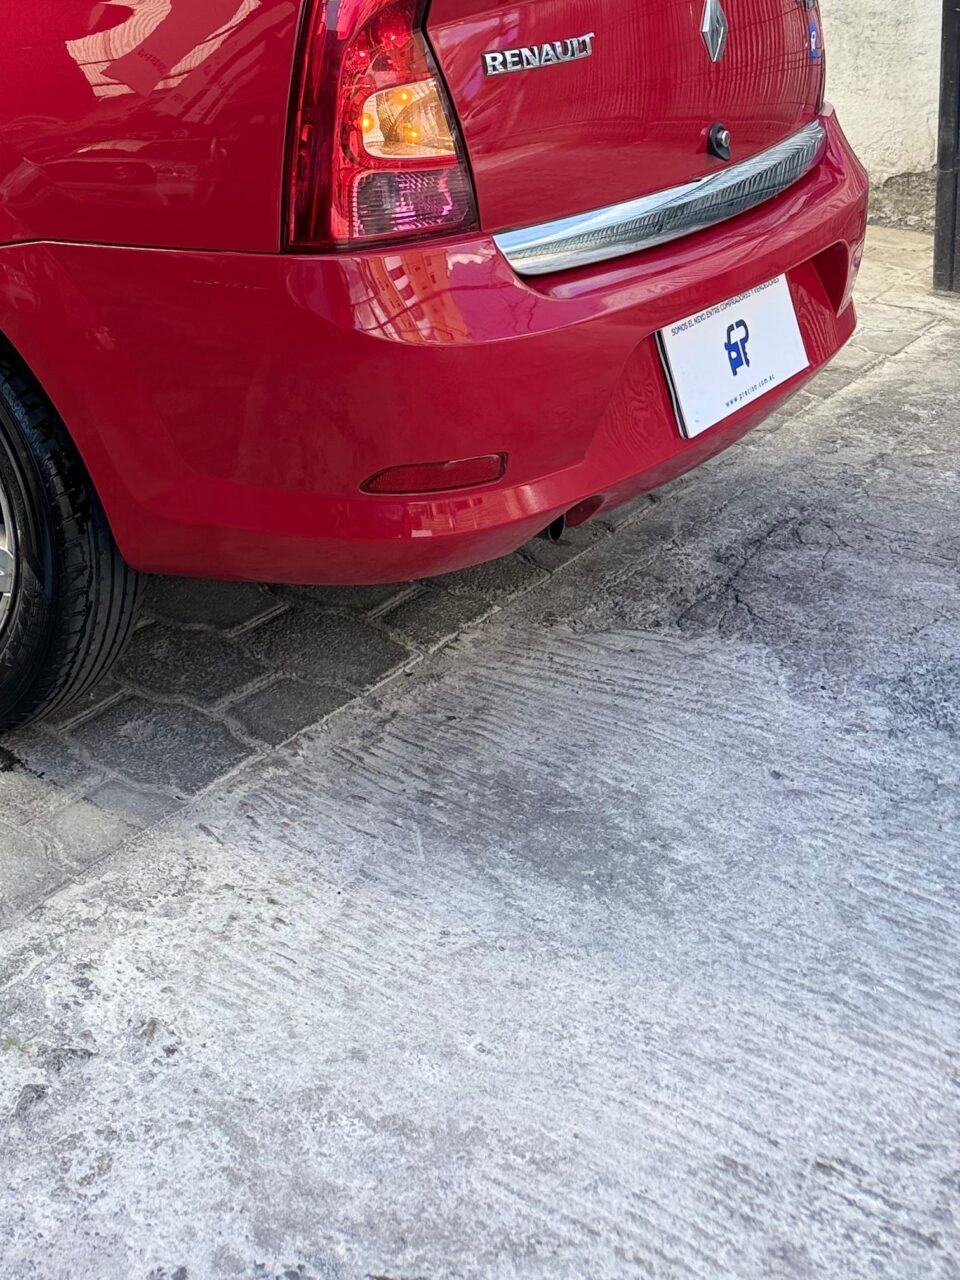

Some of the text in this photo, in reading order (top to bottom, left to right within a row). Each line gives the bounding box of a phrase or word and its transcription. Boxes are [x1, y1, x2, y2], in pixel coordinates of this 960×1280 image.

[483, 32, 595, 76] RENAULT
[671, 324, 689, 337] SOMOS
[688, 319, 695, 328] EL
[705, 306, 721, 320] ENTRE
